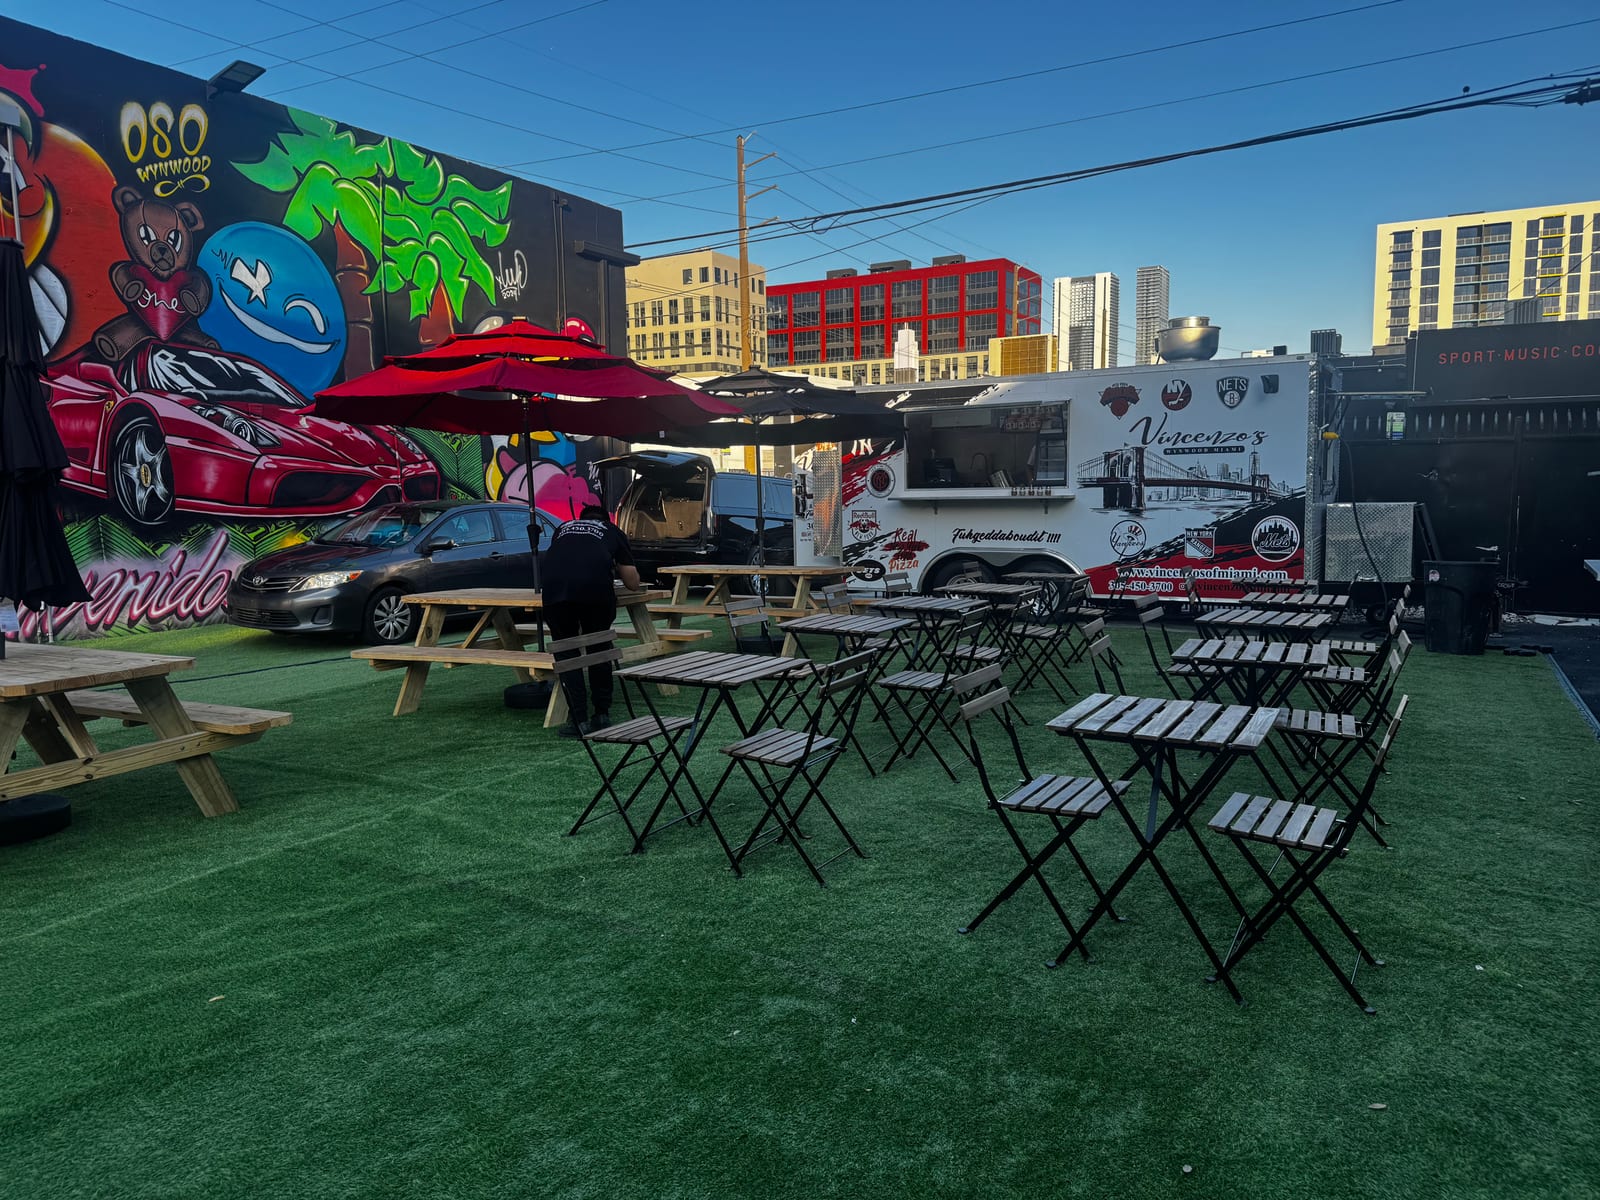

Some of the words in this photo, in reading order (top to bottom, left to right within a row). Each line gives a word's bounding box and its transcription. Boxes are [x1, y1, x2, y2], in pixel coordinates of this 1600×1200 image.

[120, 101, 209, 163] OSO
[136, 155, 211, 183] WYNWOOD
[1218, 377, 1247, 393] NETS
[1128, 412, 1269, 447] Vincenzo's
[894, 527, 918, 544] Real
[1259, 532, 1291, 548] Mets
[888, 558, 919, 573] Pizza
